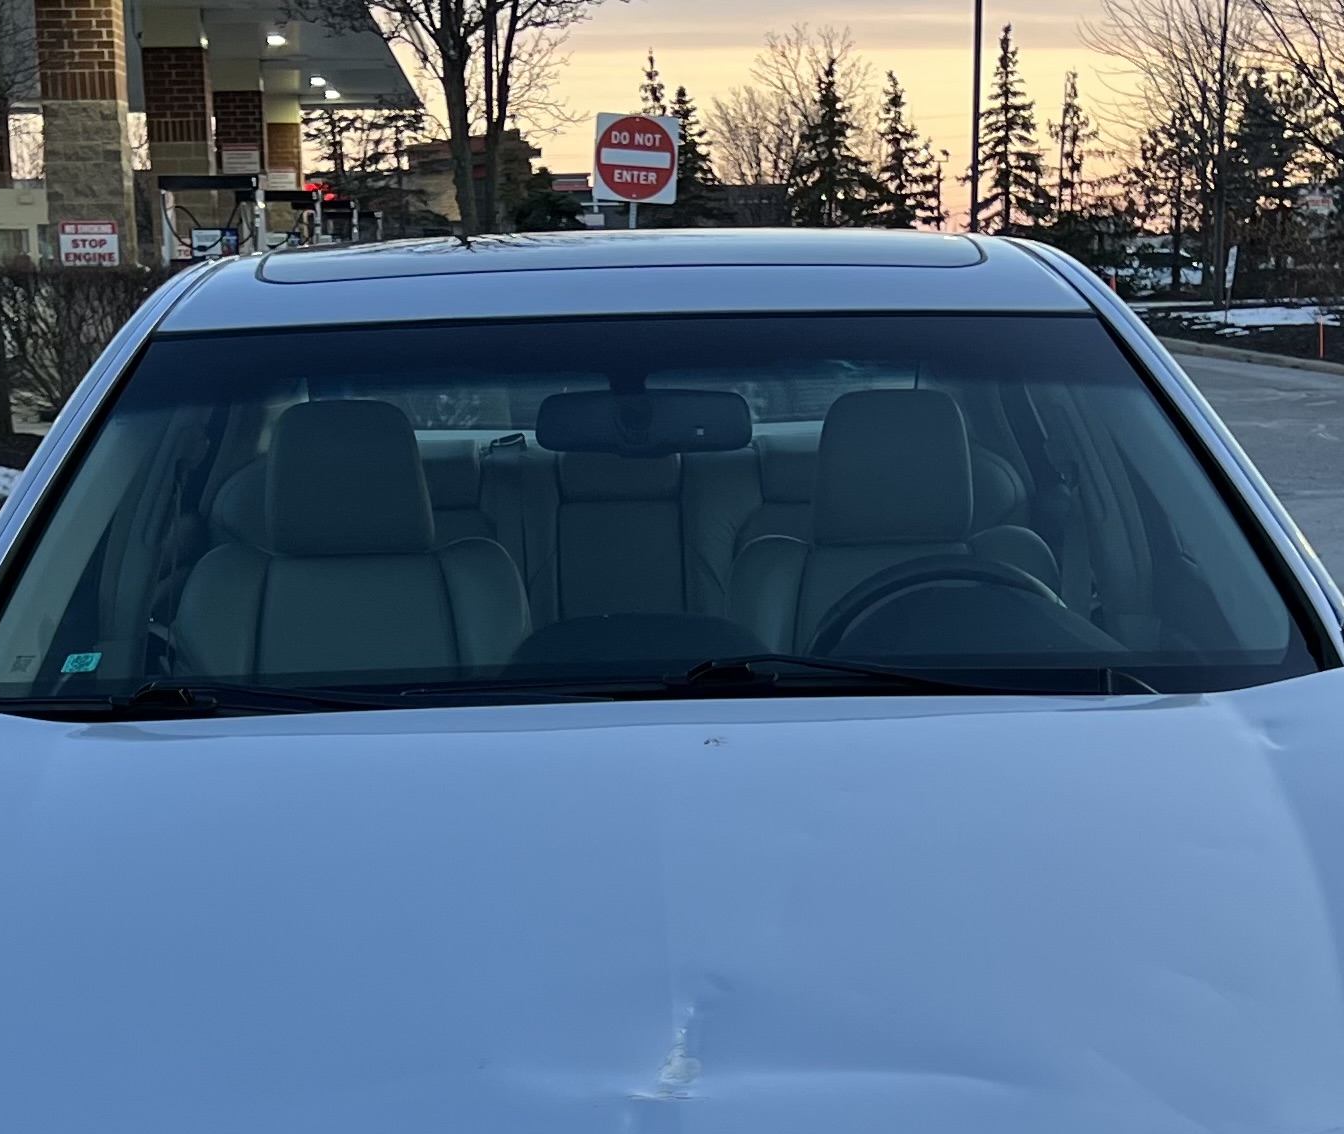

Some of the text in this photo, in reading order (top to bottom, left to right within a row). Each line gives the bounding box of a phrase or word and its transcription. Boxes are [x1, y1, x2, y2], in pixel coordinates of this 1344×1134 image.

[611, 131, 662, 147] DO NOT
[614, 169, 658, 185] ENTER
[72, 239, 108, 249] STOP
[64, 252, 116, 262] ENGINE
